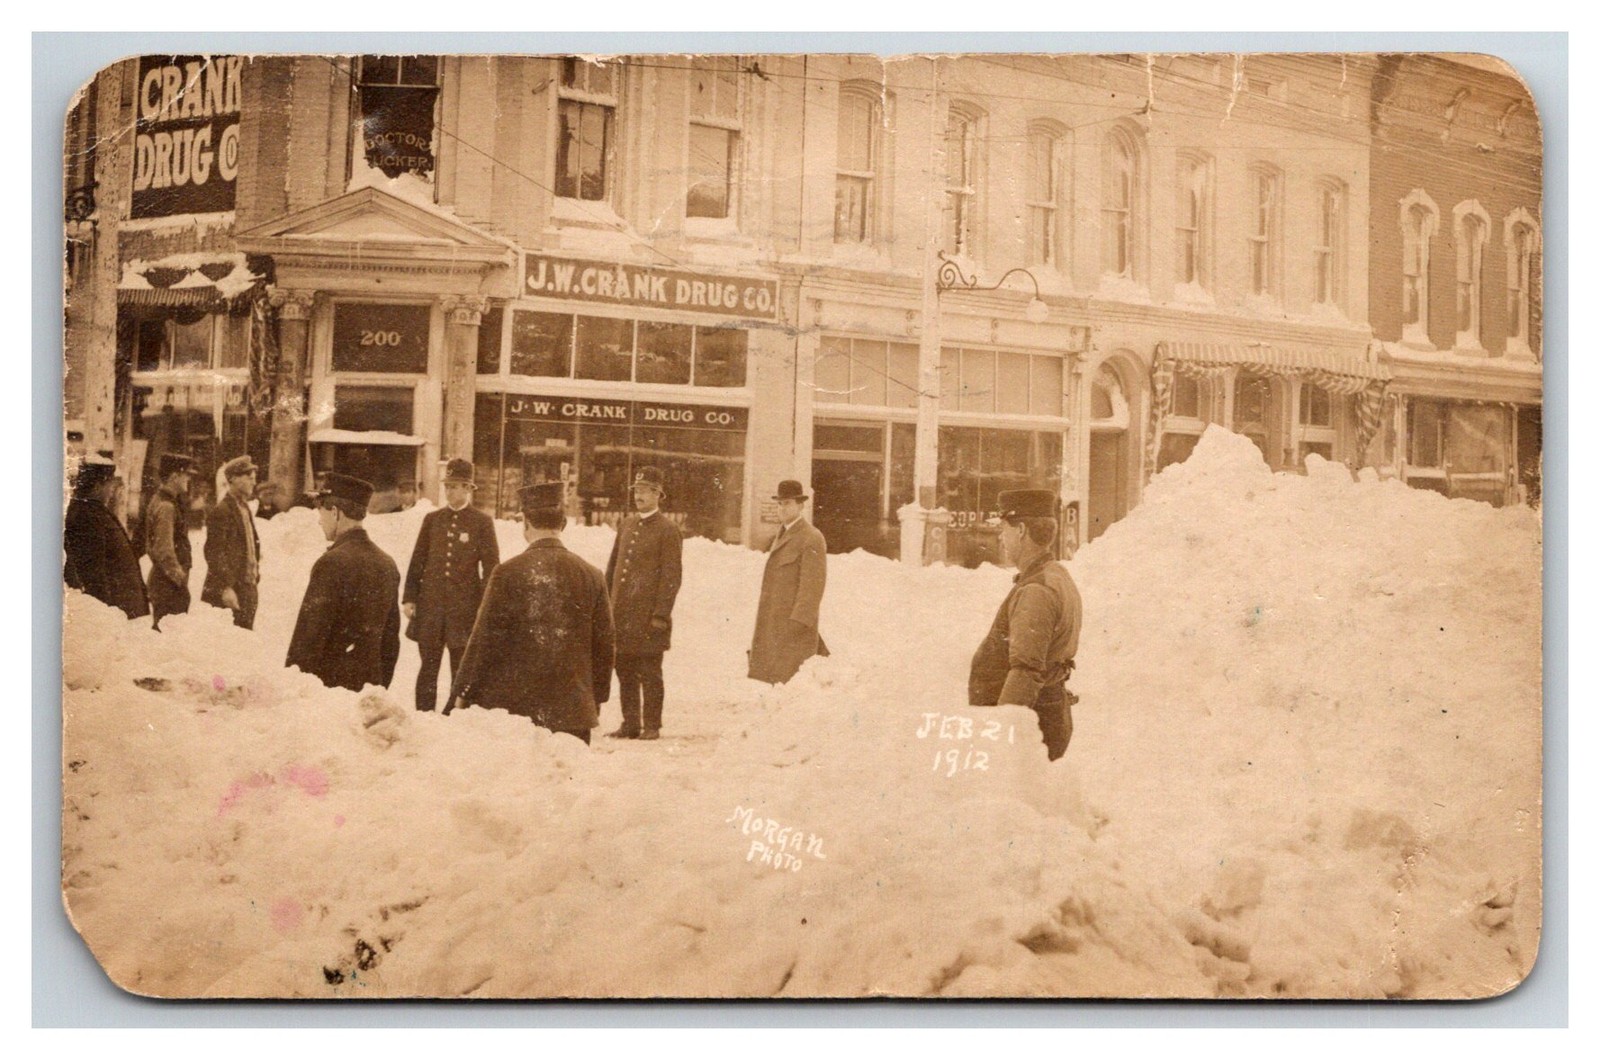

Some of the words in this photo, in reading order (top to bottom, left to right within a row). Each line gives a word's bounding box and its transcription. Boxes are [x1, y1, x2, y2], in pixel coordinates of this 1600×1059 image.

[140, 56, 243, 122] CRANK
[365, 132, 430, 152] DOCTOR
[134, 123, 214, 191] DRUG
[675, 279, 738, 309] DRUG
[743, 286, 775, 313] CO.
[360, 330, 401, 346] 200
[562, 403, 626, 419] CRANK
[644, 408, 694, 422] DRUG
